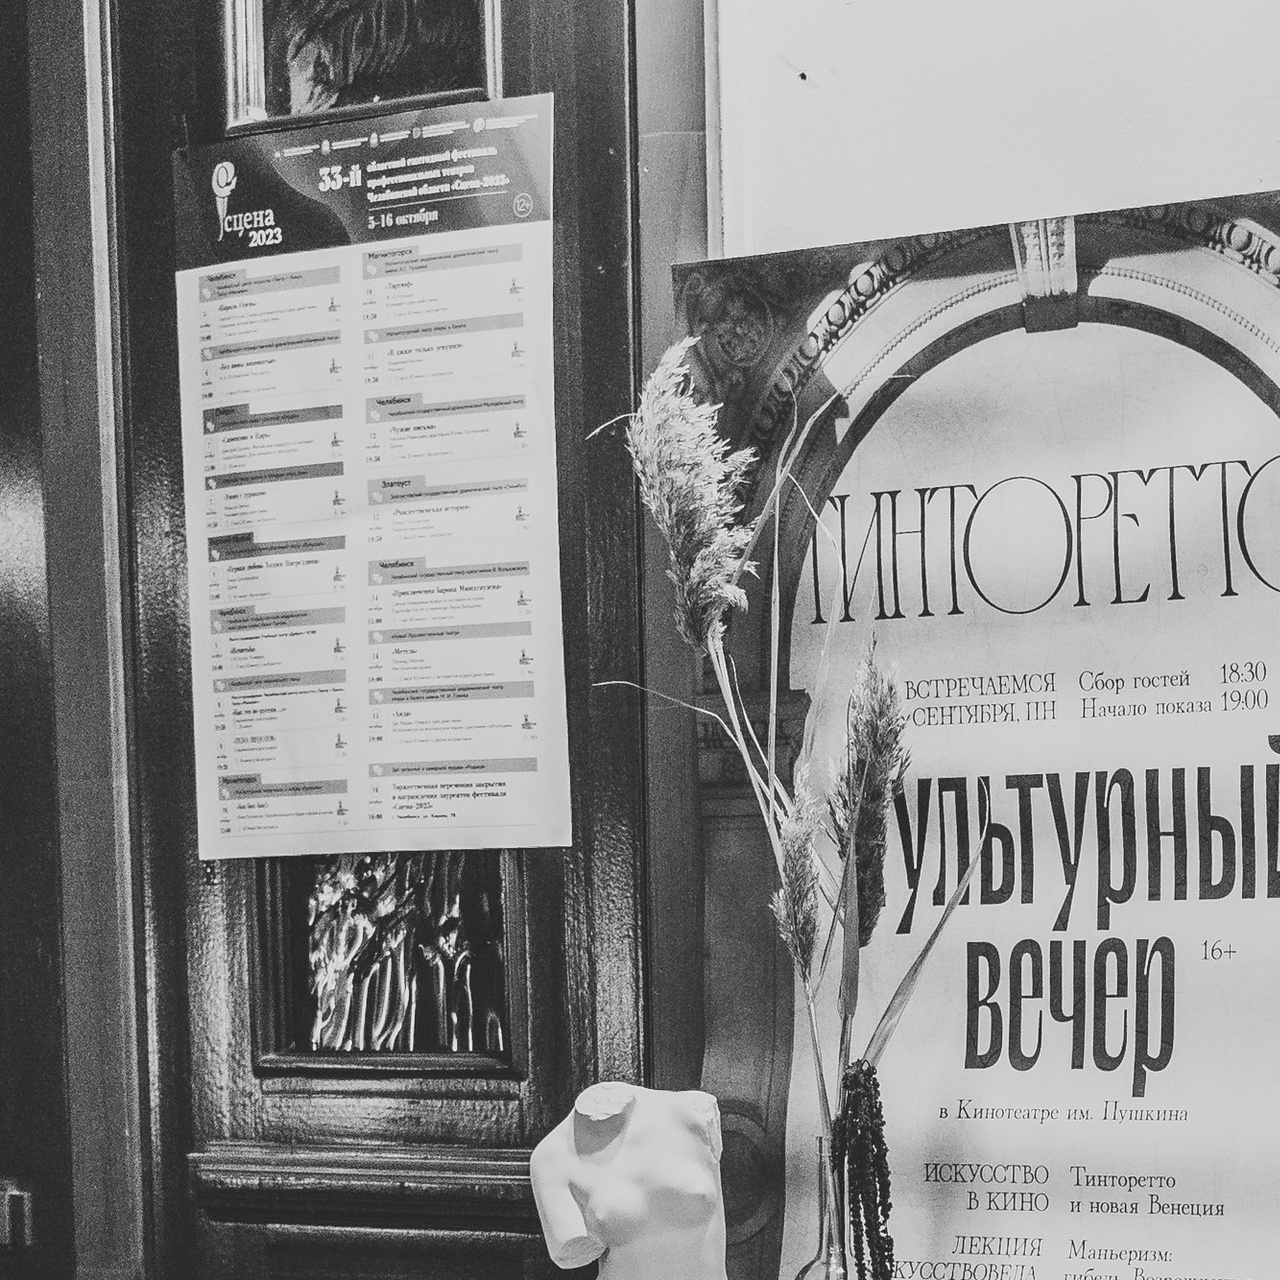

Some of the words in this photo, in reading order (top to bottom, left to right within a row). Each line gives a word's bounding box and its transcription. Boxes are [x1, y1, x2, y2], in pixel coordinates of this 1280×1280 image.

[318, 164, 362, 192] 33-й
[224, 208, 276, 238] сцена
[395, 208, 439, 225] октября
[248, 227, 283, 247] 2023
[904, 672, 1057, 700] ВСТРЕЧАЕМСЯ
[1078, 670, 1125, 695] Сбор
[1132, 669, 1191, 690] гостей
[1219, 660, 1267, 685] 18:30
[912, 702, 1021, 727] СЕНТЯБРЯ,
[1025, 700, 1057, 721] ПН
[1080, 697, 1148, 719] Начало
[1155, 699, 1213, 716] показа
[1220, 688, 1269, 712] 19:00
[1200, 938, 1238, 961] 16+
[964, 936, 1176, 1098] вечер
[955, 1099, 1059, 1124] Кинотеатре
[1066, 1107, 1094, 1121] им.
[1102, 1100, 1190, 1124] Пушкина
[923, 1163, 1050, 1185] ИСКУССТВО
[1069, 1166, 1177, 1192] Тинторетто
[966, 1191, 980, 1211] В
[986, 1191, 1050, 1212] КИНО
[1069, 1200, 1082, 1214] и
[1089, 1198, 1140, 1215] новая
[1147, 1194, 1226, 1217] Венеция
[951, 1235, 1045, 1257] ЛЕКЦИЯ
[1067, 1238, 1173, 1266] Маньеризм:
